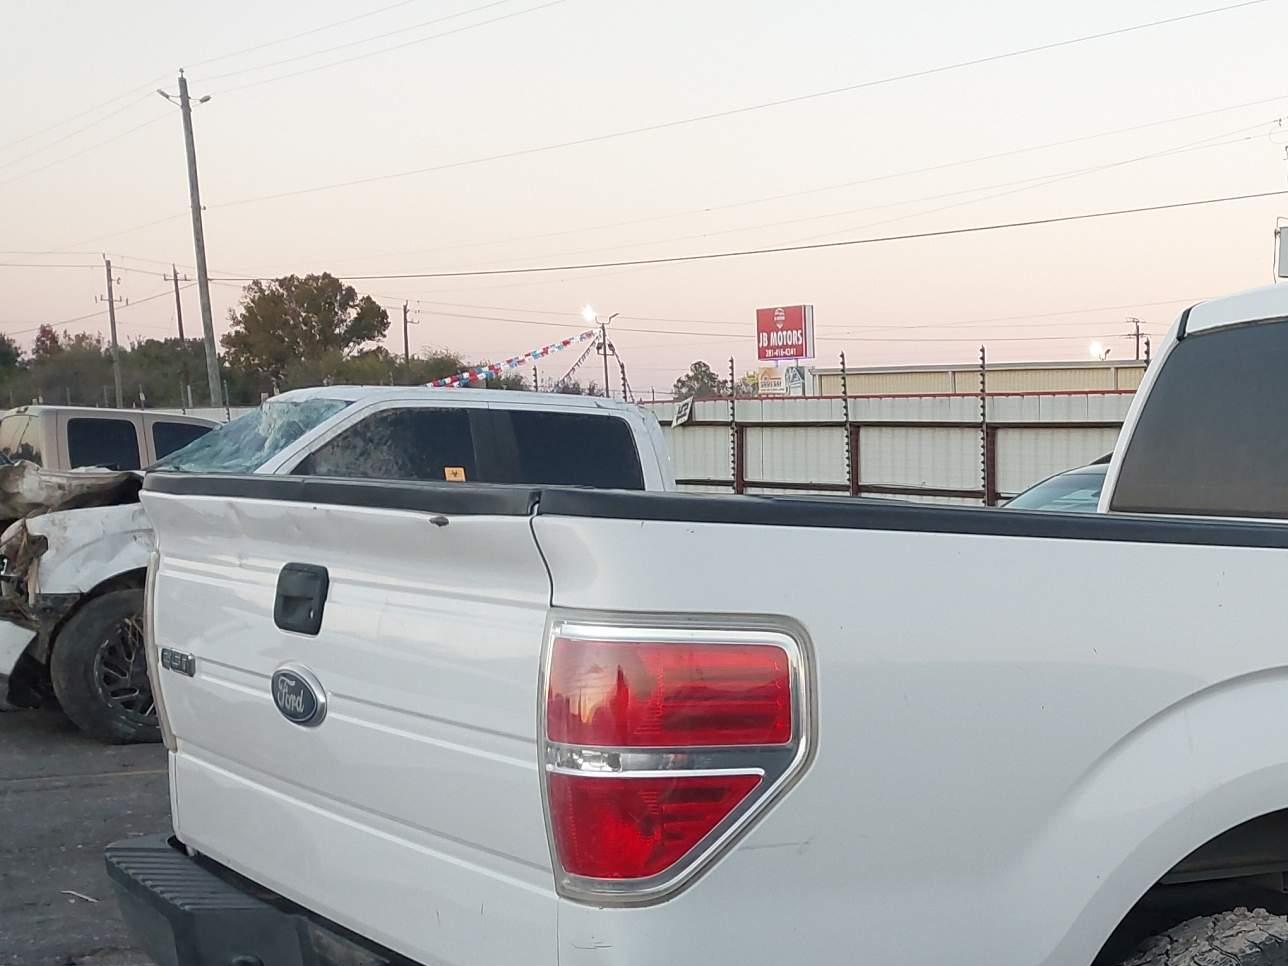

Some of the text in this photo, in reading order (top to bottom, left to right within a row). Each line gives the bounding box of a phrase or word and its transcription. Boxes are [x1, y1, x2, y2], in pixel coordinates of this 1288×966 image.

[759, 329, 803, 348] JB MOTORS
[277, 676, 305, 713] Ford
